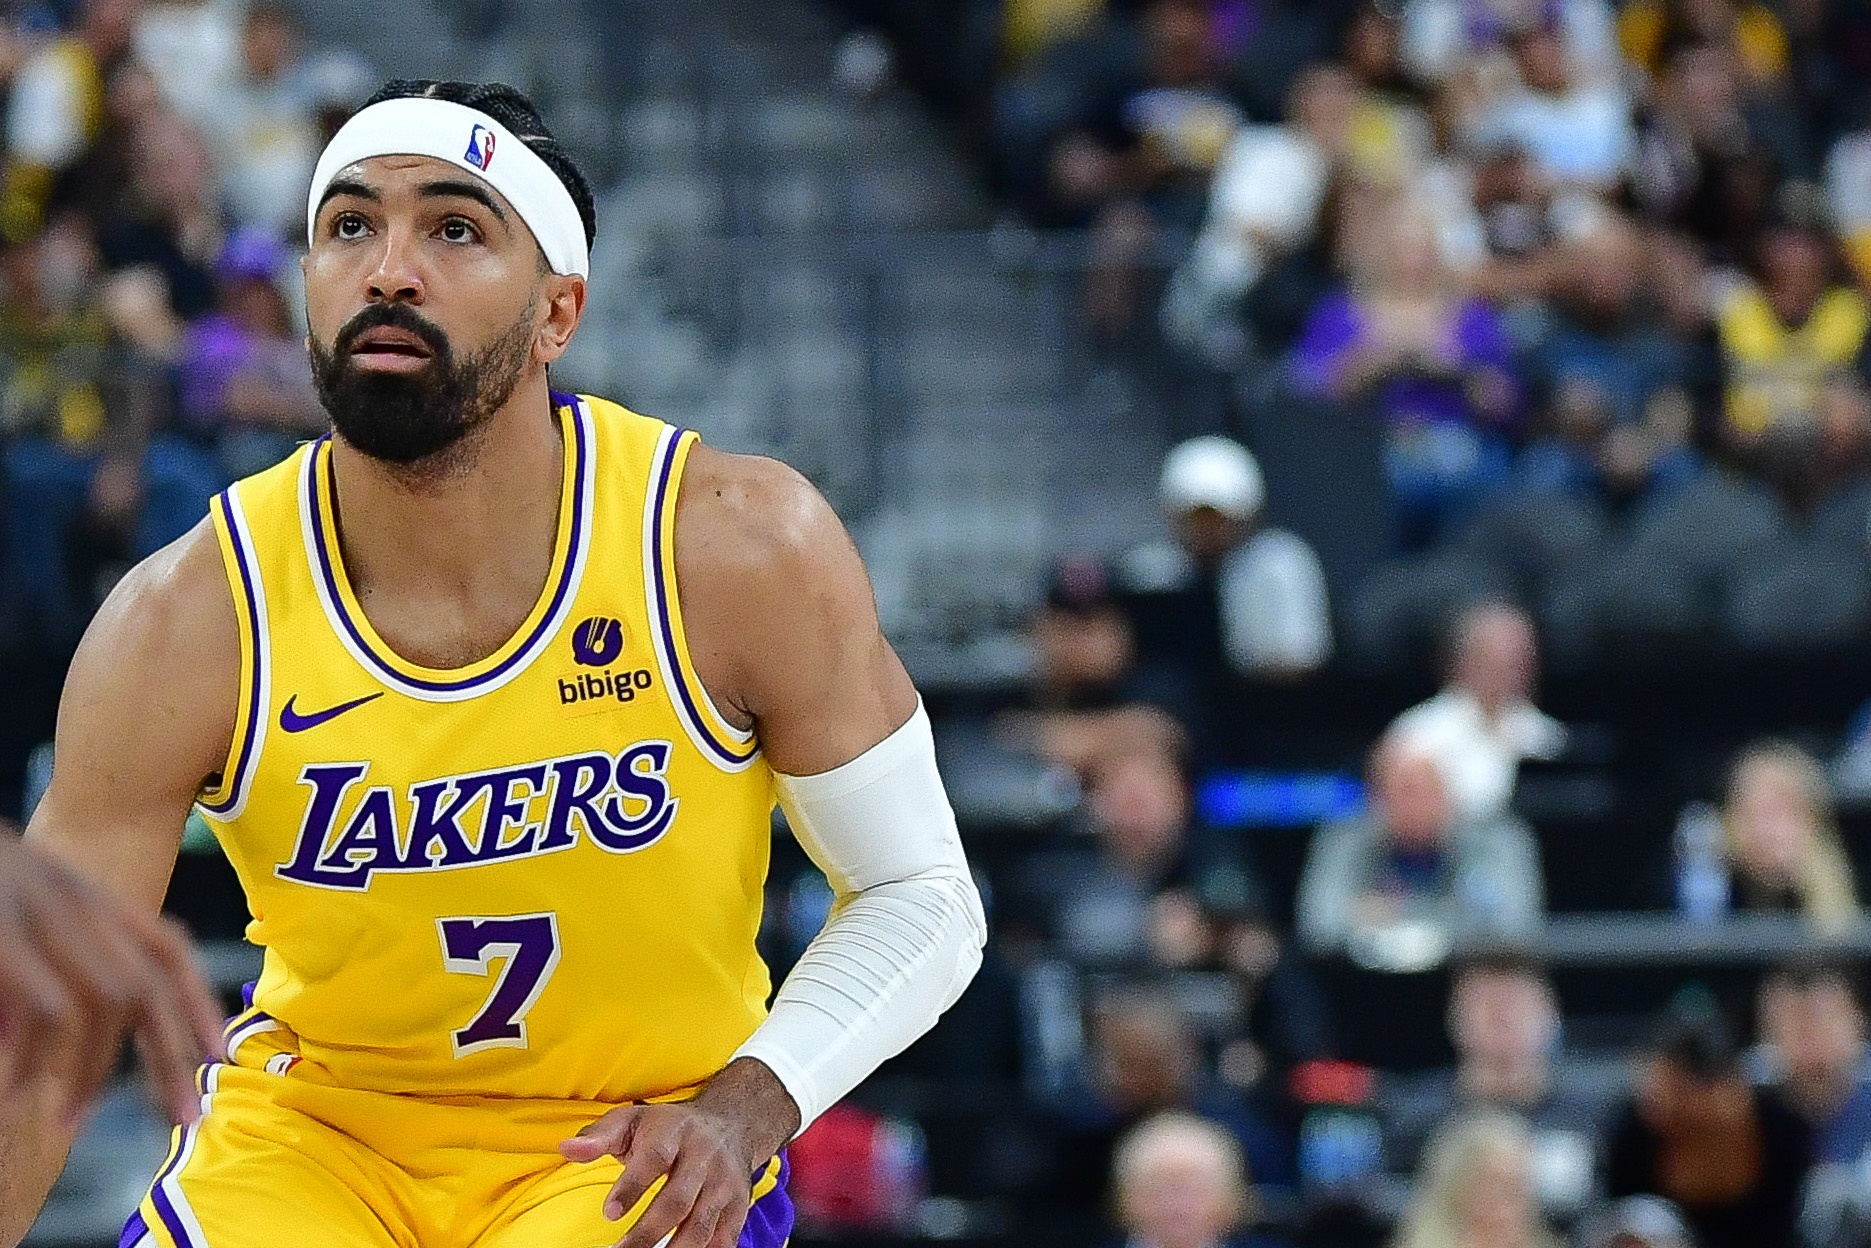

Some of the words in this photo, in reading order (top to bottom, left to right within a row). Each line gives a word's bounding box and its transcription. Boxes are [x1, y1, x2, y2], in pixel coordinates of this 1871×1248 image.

[558, 669, 652, 705] bibigo
[275, 739, 680, 892] LAKERS
[436, 912, 562, 1059] 7
